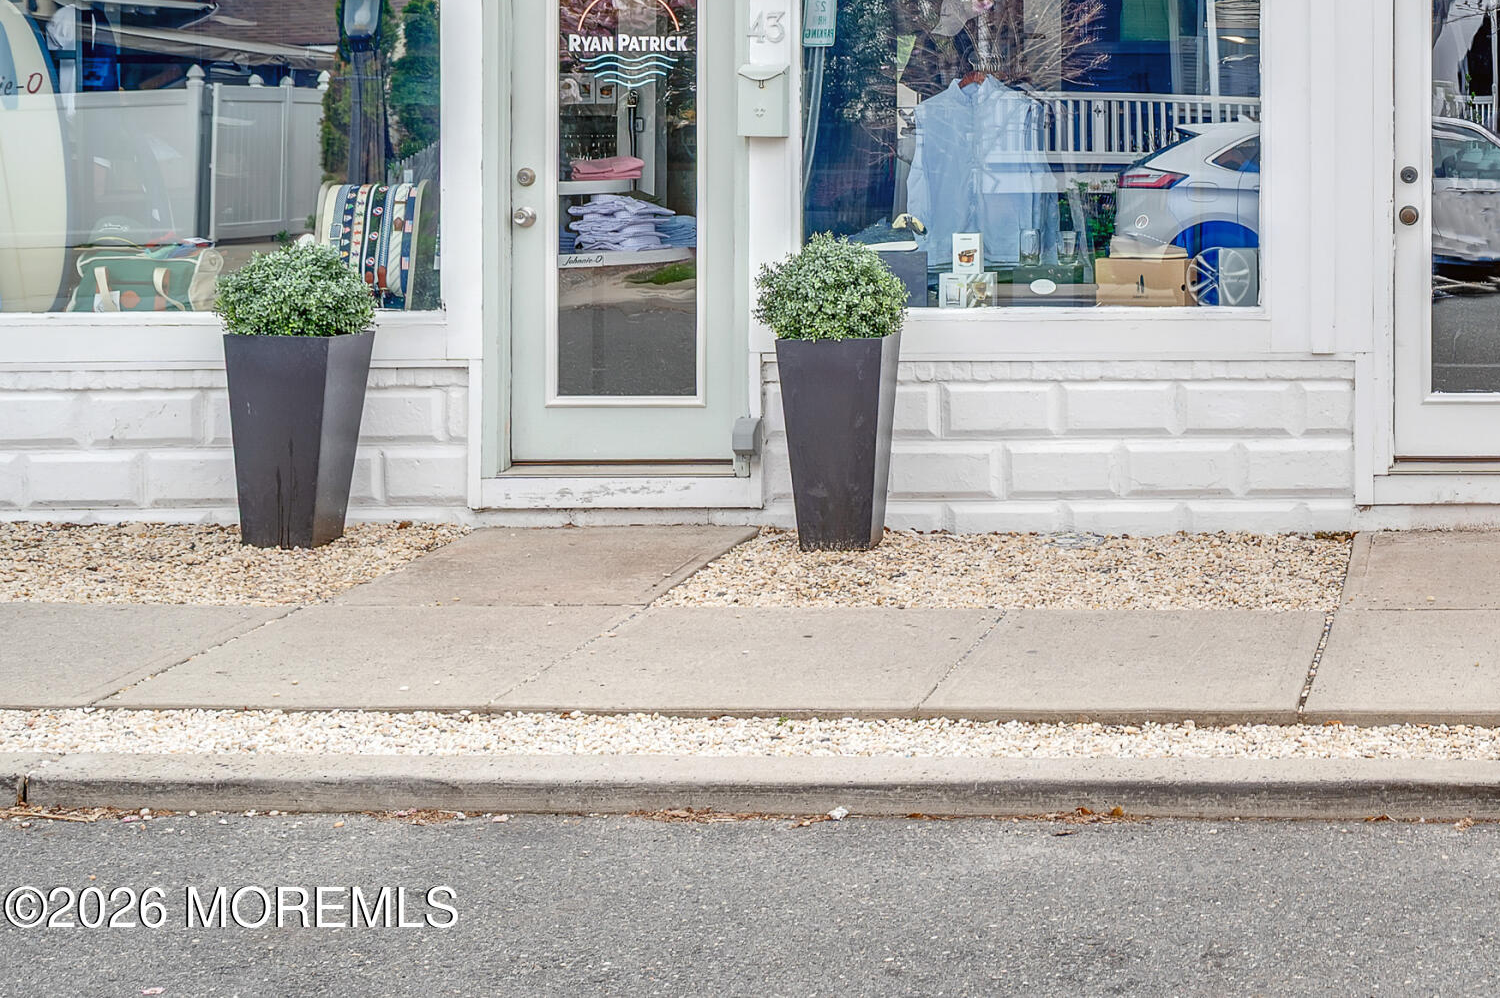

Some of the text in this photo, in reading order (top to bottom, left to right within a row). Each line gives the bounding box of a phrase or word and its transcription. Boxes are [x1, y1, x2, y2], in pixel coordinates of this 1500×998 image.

[746, 10, 786, 44] 43
[568, 33, 689, 52] RYAN PATRICK
